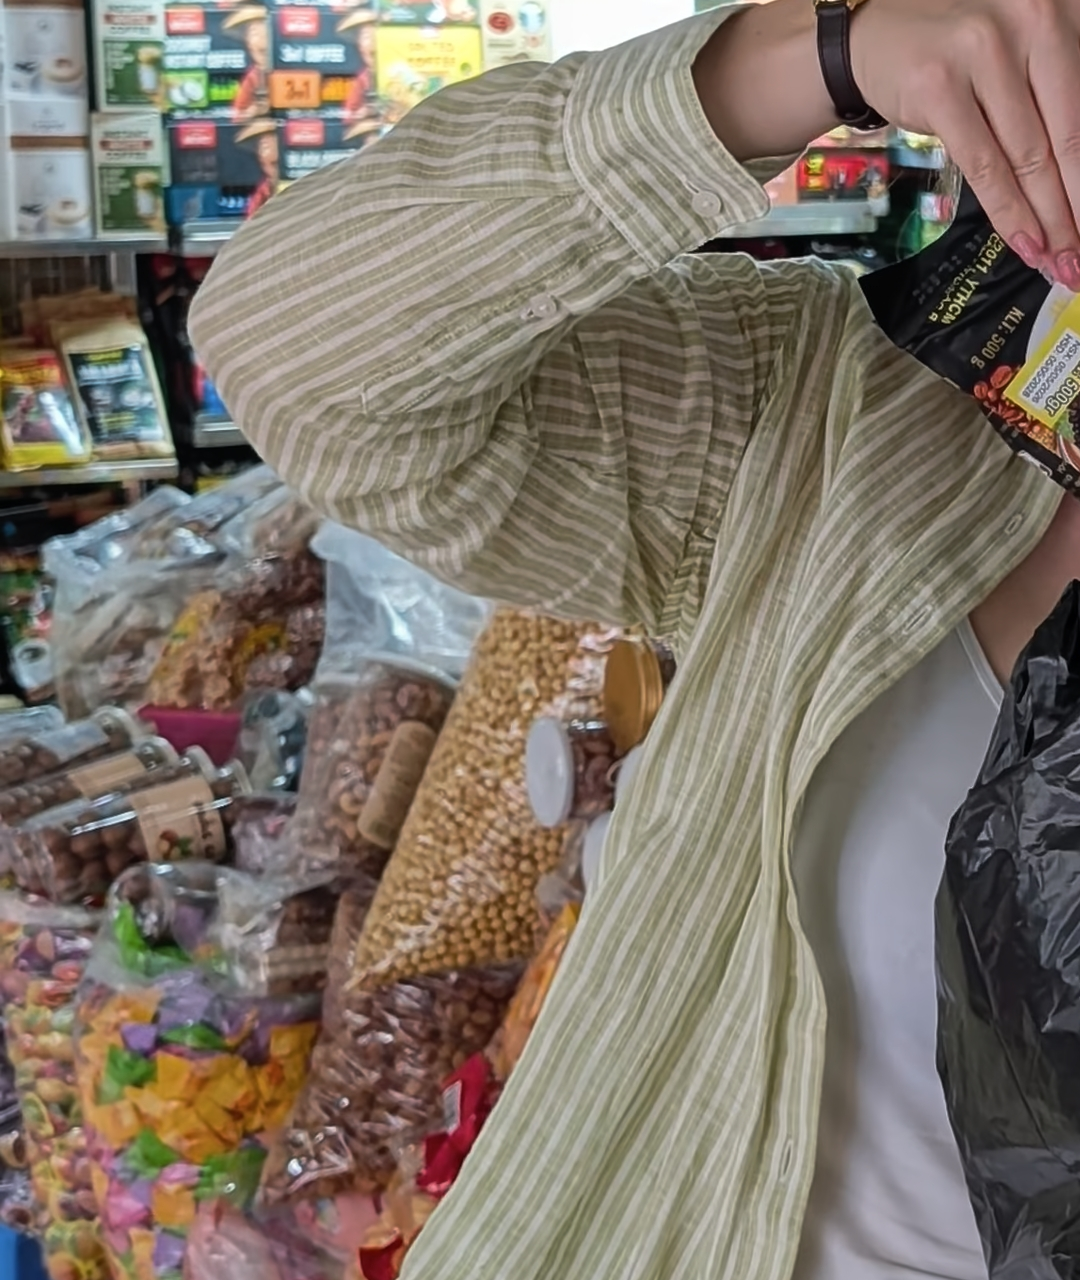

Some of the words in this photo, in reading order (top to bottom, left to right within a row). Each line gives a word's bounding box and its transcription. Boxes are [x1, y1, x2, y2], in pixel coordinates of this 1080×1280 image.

[938, 275, 980, 327] YTHCM
[997, 305, 1025, 336] KLT:
[980, 332, 1006, 360] 500
[1052, 332, 1073, 356] HSD:
[969, 354, 986, 370] g
[1039, 373, 1080, 419] 500gr
